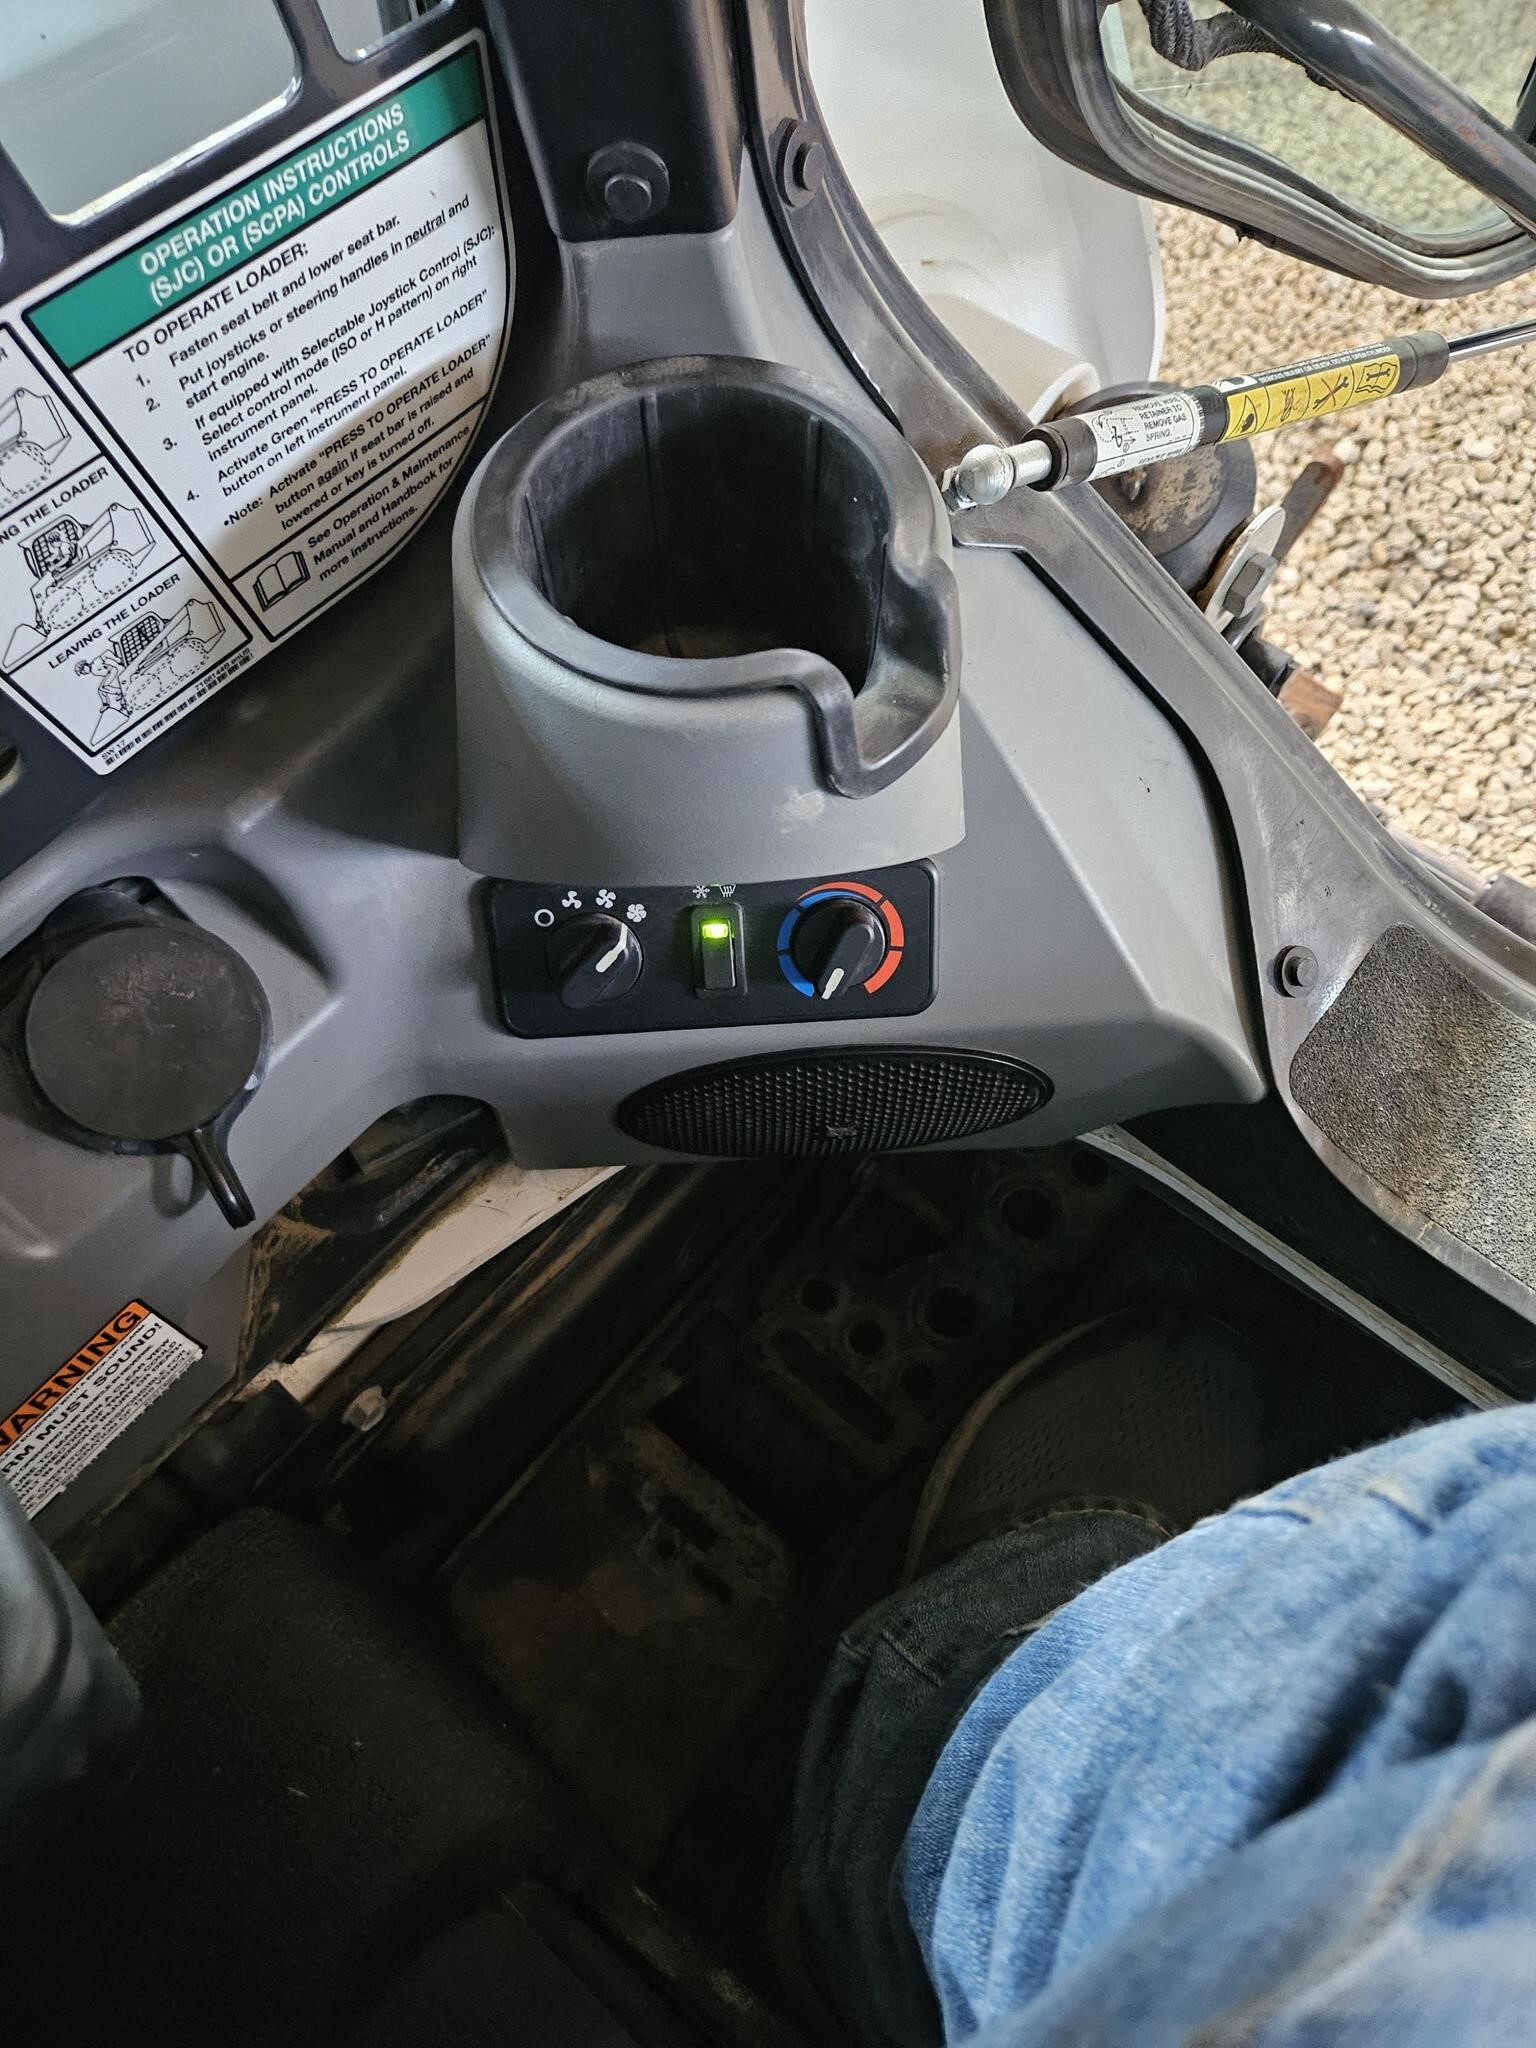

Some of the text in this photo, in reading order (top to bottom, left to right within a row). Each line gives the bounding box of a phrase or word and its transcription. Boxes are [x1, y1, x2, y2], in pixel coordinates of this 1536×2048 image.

[139, 102, 404, 275] OPERATION INSTRUCTIONS
[149, 129, 409, 307] (SJC) OR (SCPA) CONTROLS
[121, 242, 308, 363] TO OPERATE LOADER:
[134, 215, 400, 387] 1. Fasten seat belt and lower seat bar.
[144, 193, 469, 413] 2. Put joysticks or steering handles in neutral and
[162, 224, 495, 451] 3. If equipped with Selectable Joystick Control (SJC):
[201, 254, 477, 446] Select control mode (ISO or H pattern) on right
[185, 351, 269, 409] start engine.
[186, 489, 200, 501] 4.
[217, 442, 268, 483] Activate
[270, 415, 309, 445] Green
[358, 365, 377, 384] TO
[379, 325, 435, 371] OPERATE
[207, 382, 318, 462] instrument panel.
[221, 364, 407, 497] button on left instrument panel.
[269, 458, 317, 498] Activate
[365, 409, 384, 428] TO
[385, 370, 440, 415] OPERATE
[274, 365, 474, 514] button again if seat bar is raised and
[1144, 413, 1187, 431] REMOVE GAS
[21, 503, 51, 528] THE
[53, 466, 109, 508] LOADER
[280, 415, 435, 530] lowered or key is turned off.
[306, 427, 470, 548] See Operation & Maintenance
[312, 455, 457, 565] Manual and Handbook for
[318, 505, 418, 582] more instructions.
[48, 573, 181, 669] LEAVING THE LOADER
[35, 1389, 89, 1440] MUST
[92, 1322, 162, 1387] SOUND!
[15, 1478, 33, 1496] HE
[22, 1493, 37, 1508] HE
[24, 1501, 37, 1513] HE
